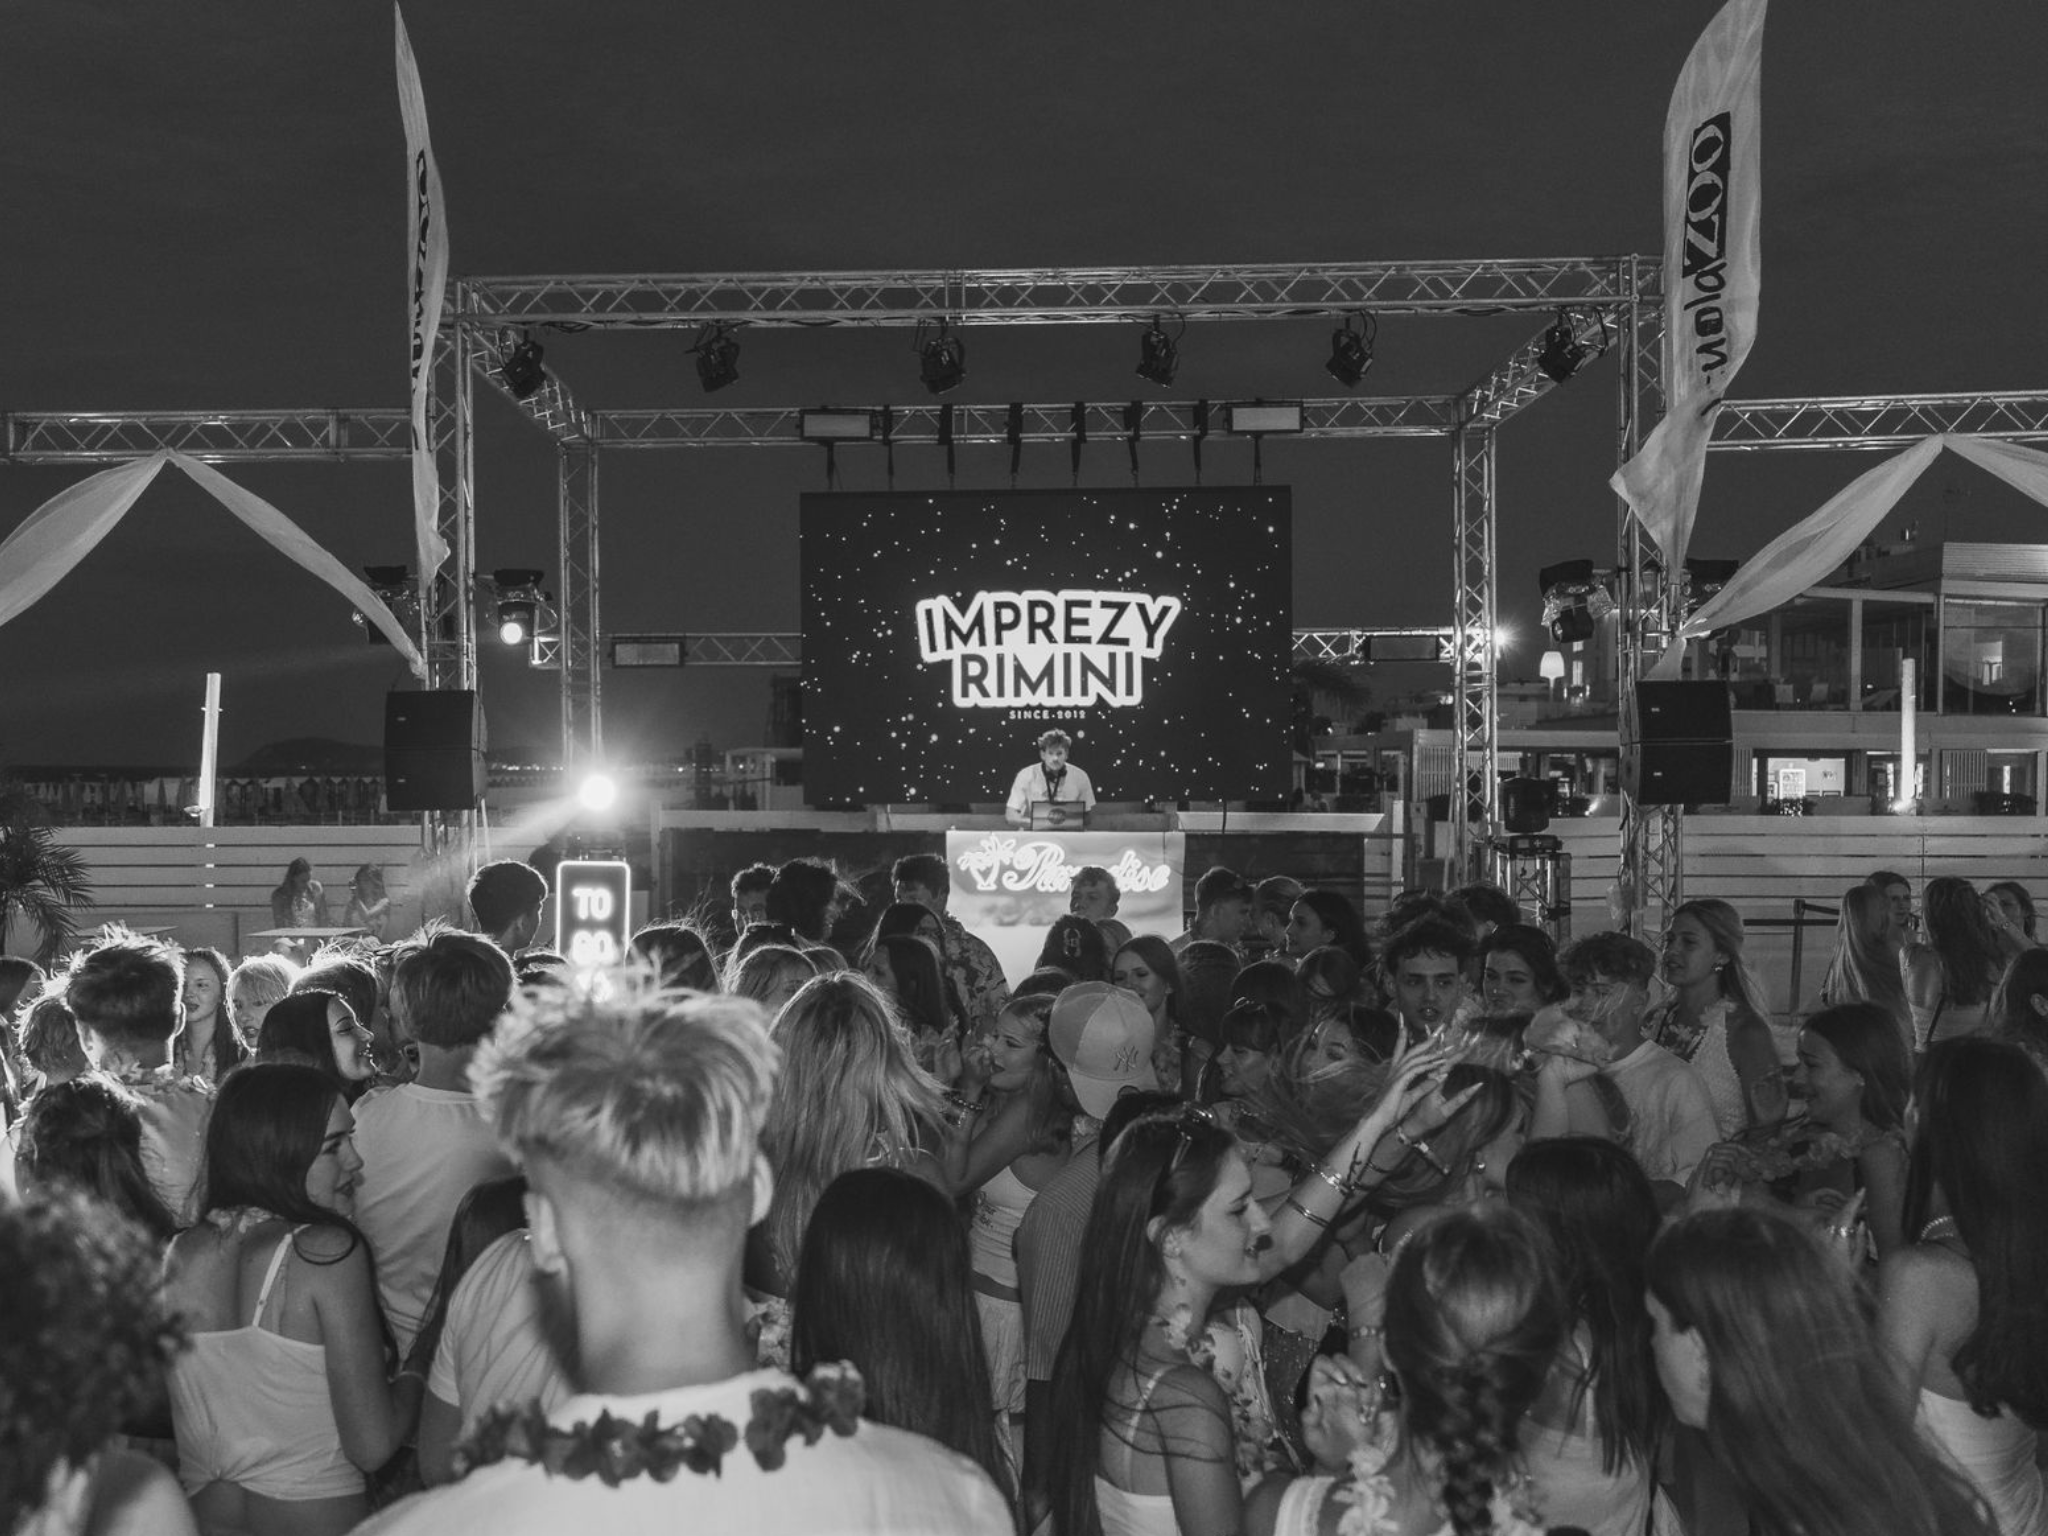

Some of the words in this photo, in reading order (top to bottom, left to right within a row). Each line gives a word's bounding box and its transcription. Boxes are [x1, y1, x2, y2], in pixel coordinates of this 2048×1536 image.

[923, 598, 1172, 653] IMPREZY
[961, 652, 1134, 698] RIMINI
[1008, 709, 1050, 719] SINCE
[1003, 842, 1170, 892] Pardise
[572, 888, 612, 920] TO
